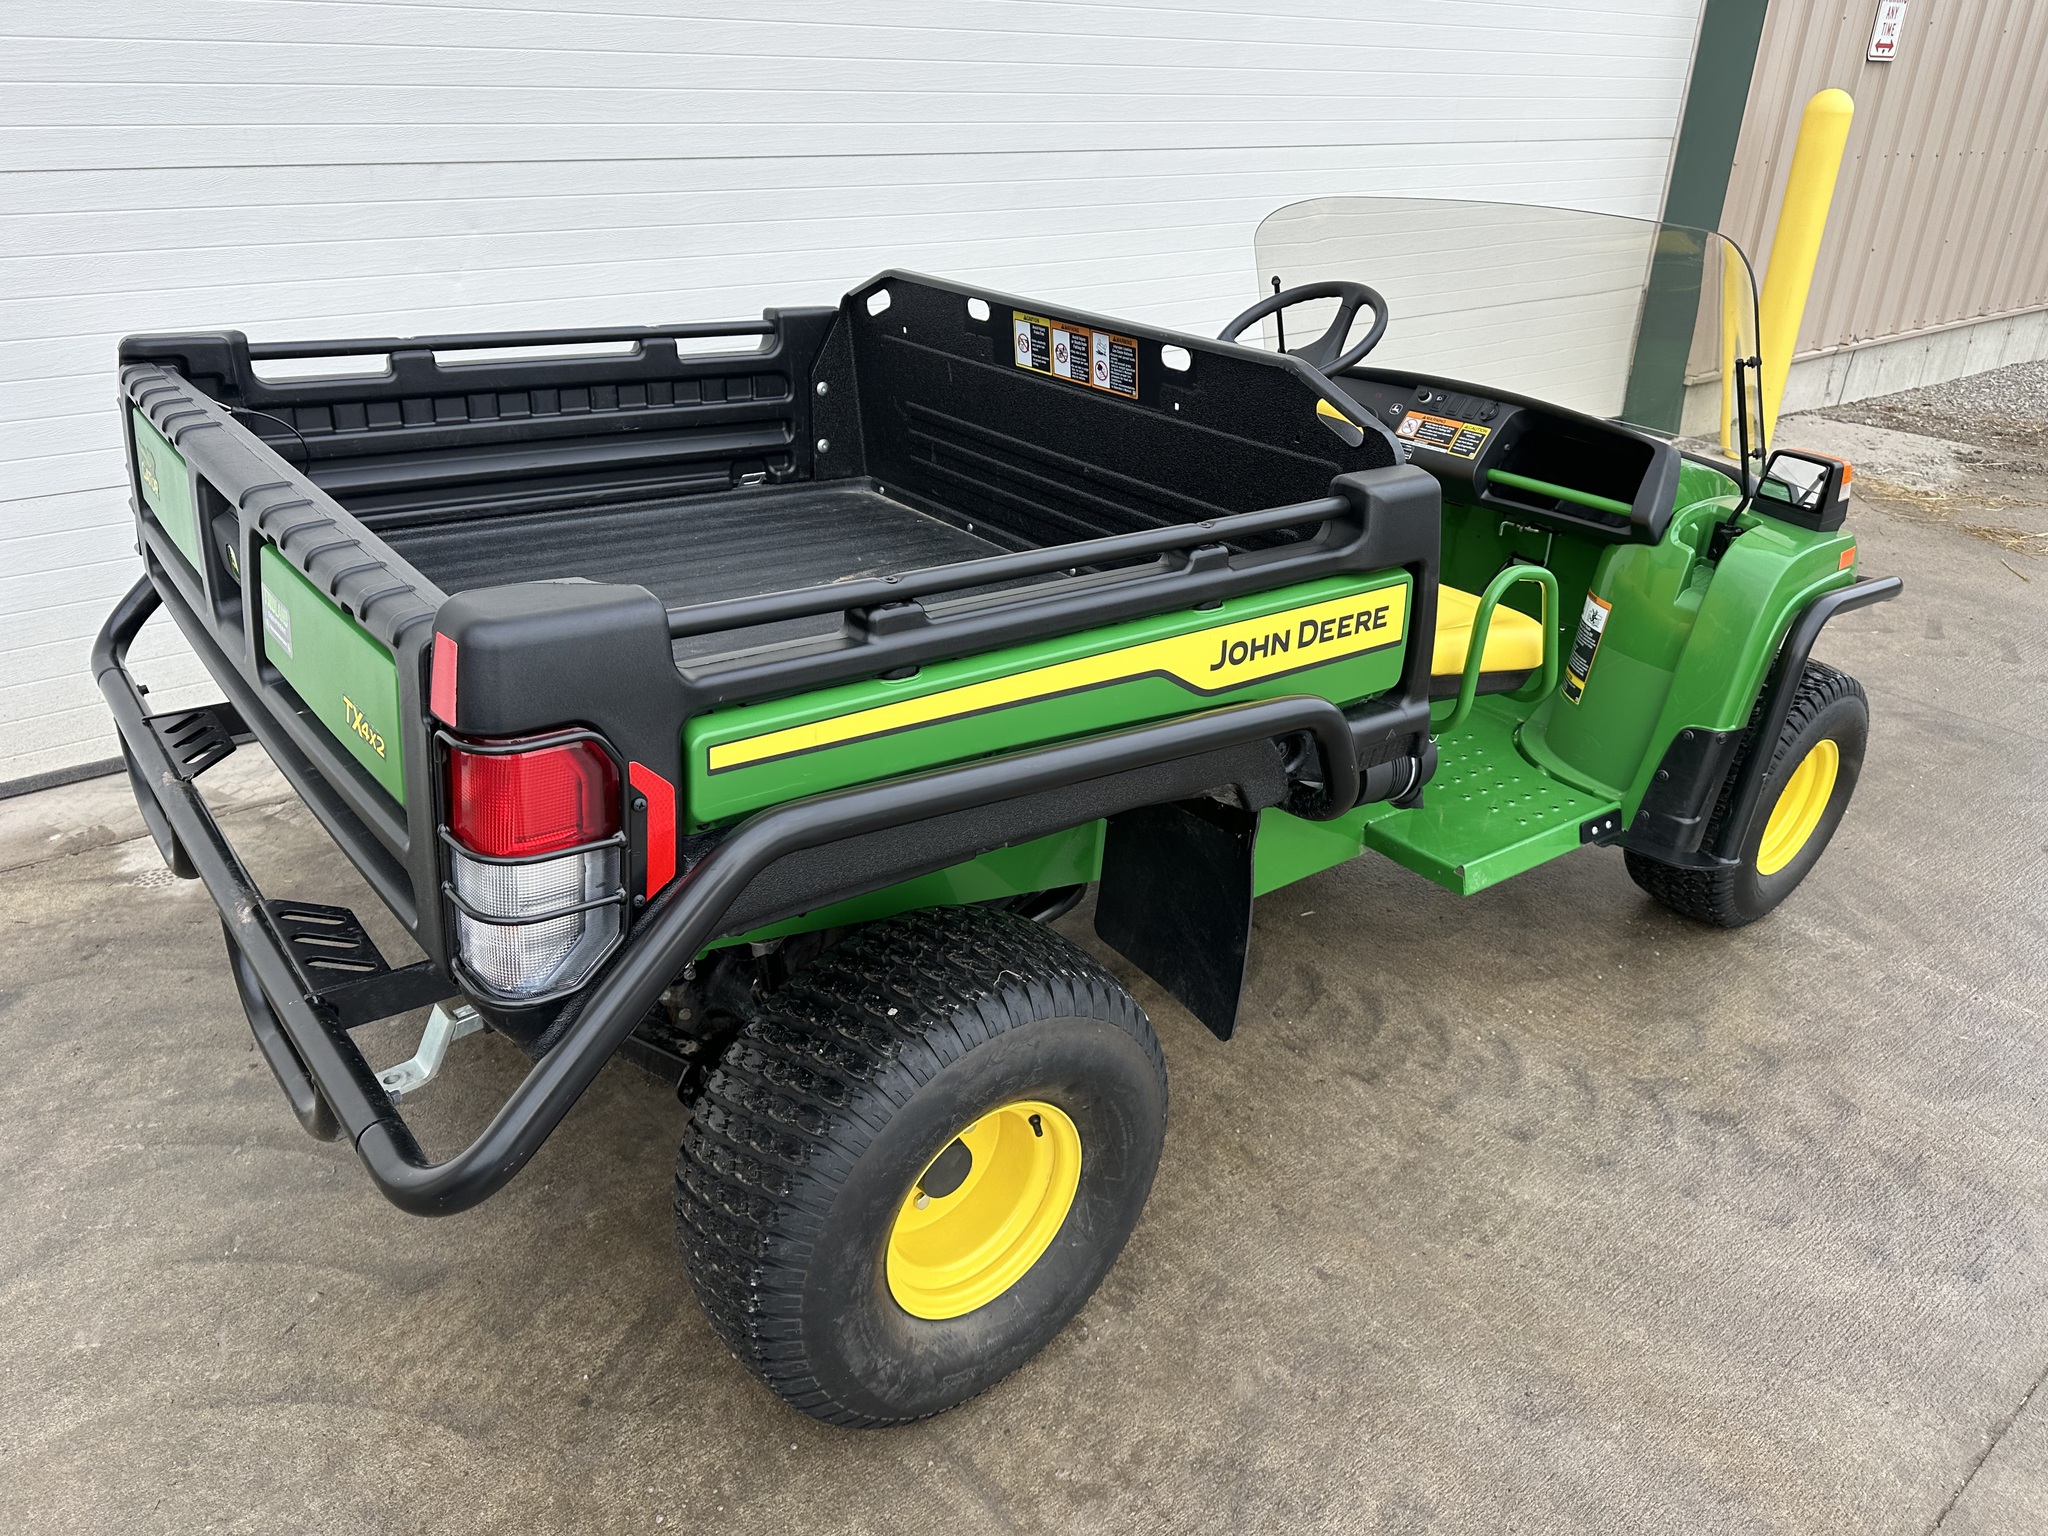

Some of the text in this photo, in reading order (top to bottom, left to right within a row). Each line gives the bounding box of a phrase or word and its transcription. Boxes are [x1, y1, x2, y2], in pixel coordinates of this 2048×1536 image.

[1886, 6, 1899, 19] ANY
[1881, 22, 1896, 36] TIME
[1210, 605, 1390, 671] JOHN DEERE
